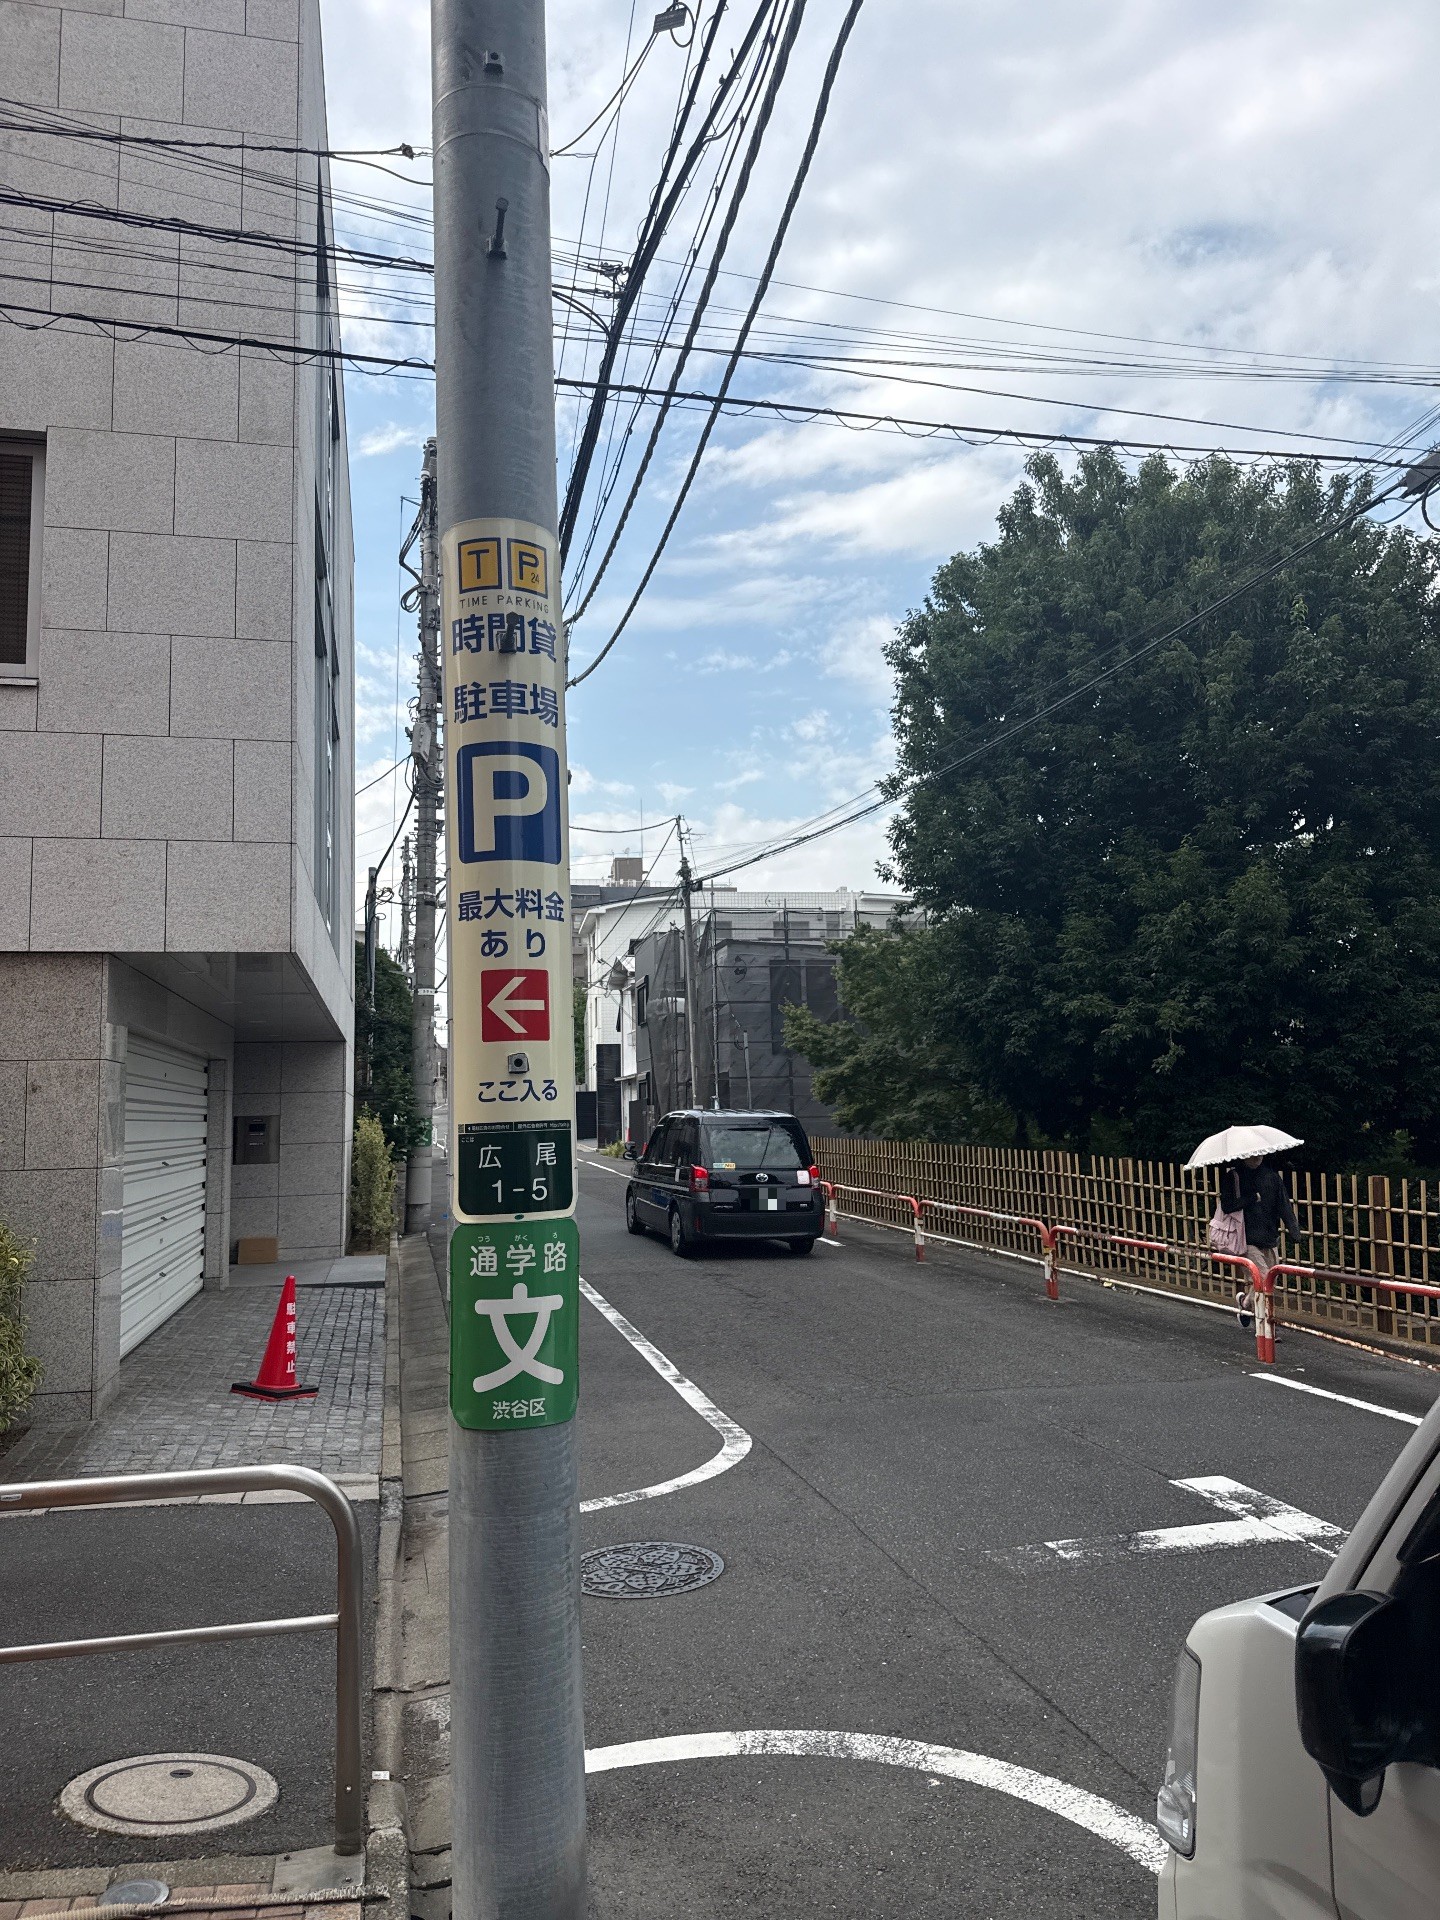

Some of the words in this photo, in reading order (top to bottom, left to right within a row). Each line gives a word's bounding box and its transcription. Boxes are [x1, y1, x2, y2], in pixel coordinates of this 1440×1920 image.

[467, 548, 490, 580] T
[518, 550, 540, 581] P
[459, 595, 488, 609] TIME
[497, 594, 549, 614] PARKING
[453, 679, 559, 729] 駐車場
[471, 753, 548, 853] P
[458, 887, 565, 922] 最大料金
[480, 929, 546, 958] あり
[478, 1079, 558, 1103] ここ入る
[491, 1177, 548, 1203] 1-5
[469, 1240, 567, 1277] 通学路
[472, 1282, 564, 1393] 文
[492, 1397, 546, 1421] 渋谷区
